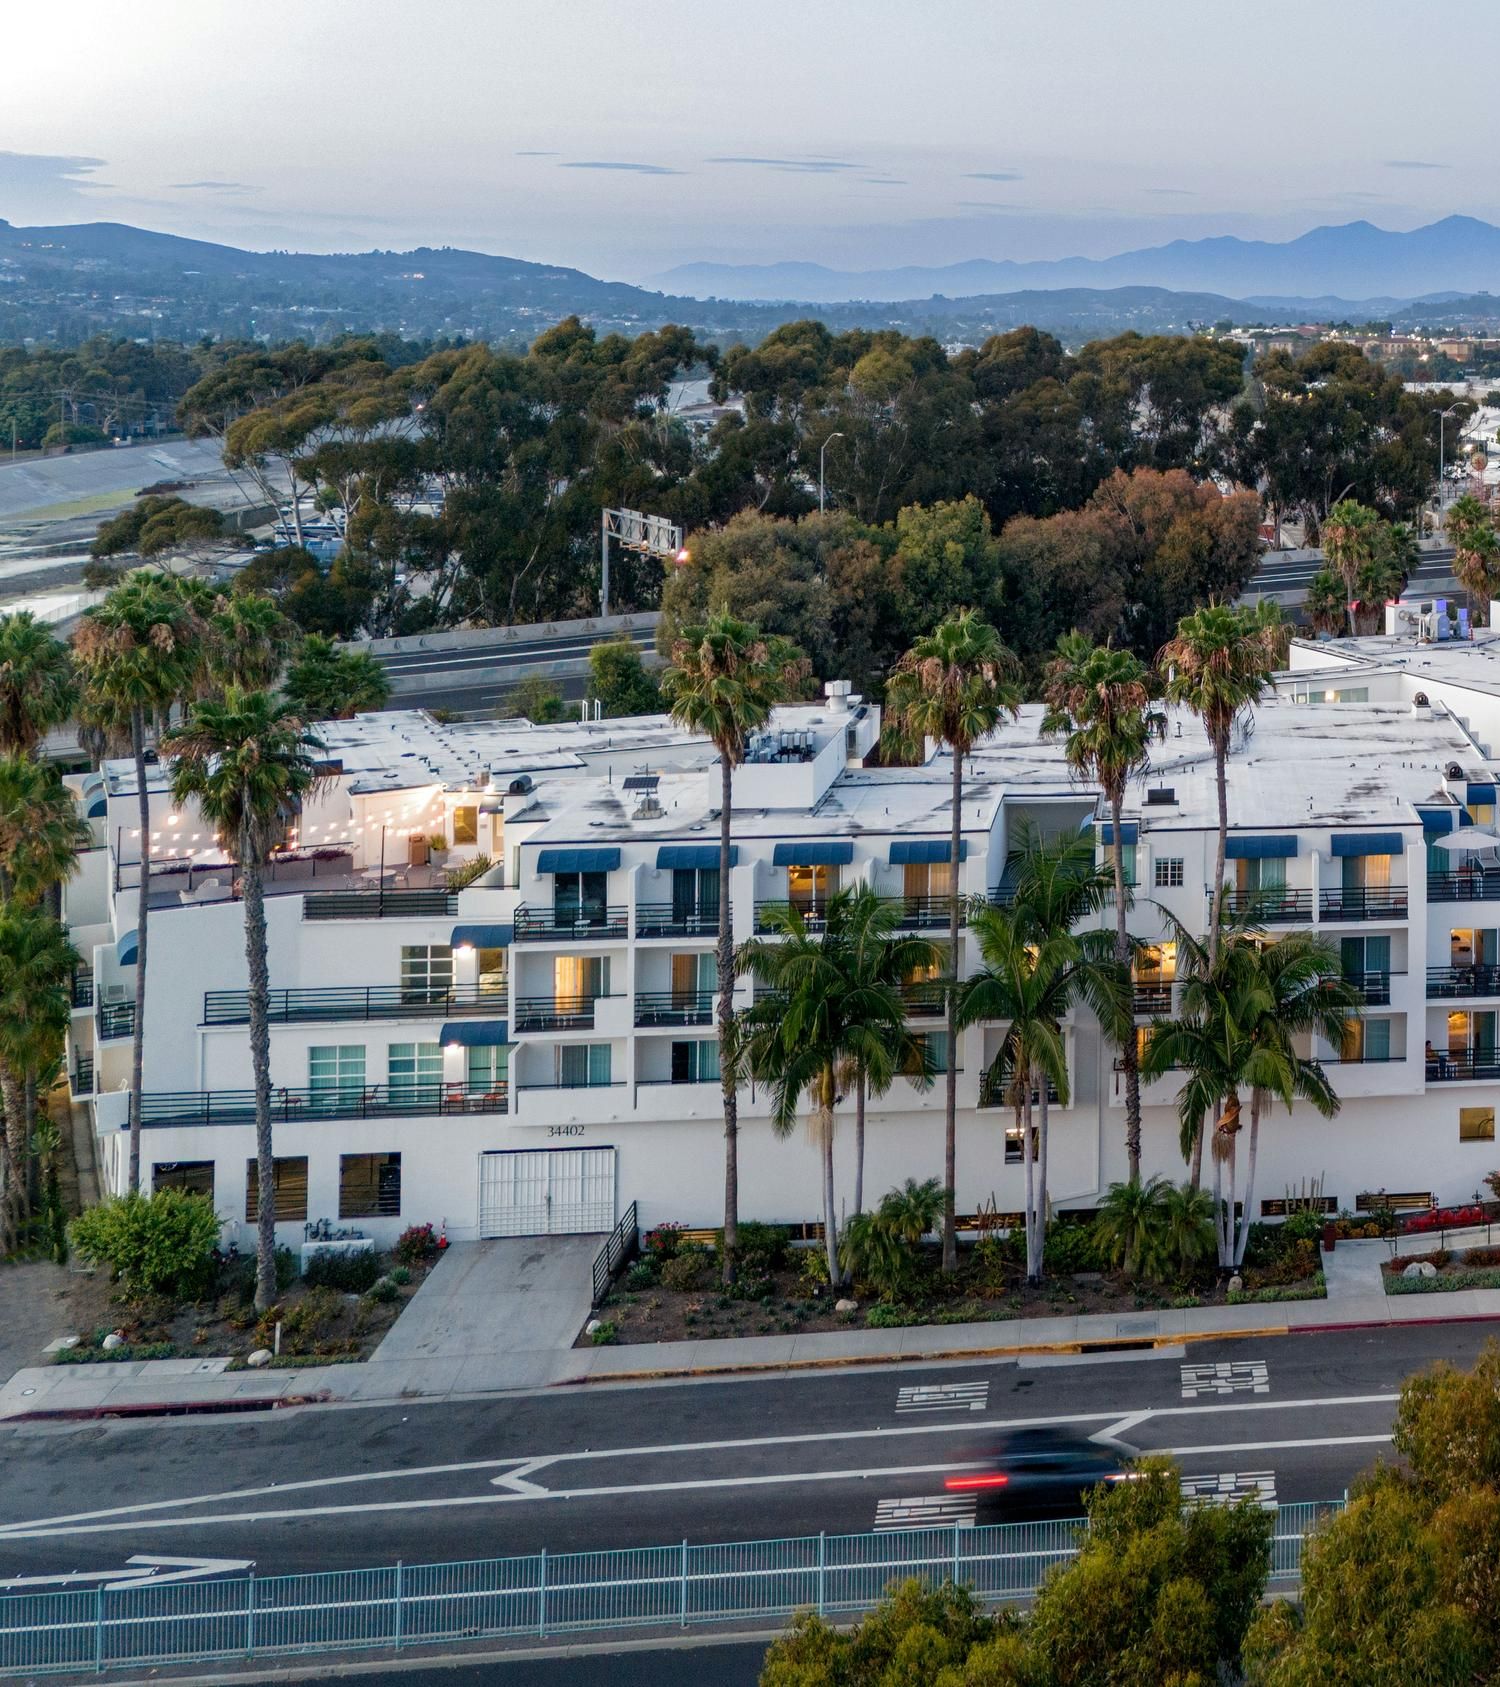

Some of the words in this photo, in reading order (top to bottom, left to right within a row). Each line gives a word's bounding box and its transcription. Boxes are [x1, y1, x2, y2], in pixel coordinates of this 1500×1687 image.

[547, 1124, 585, 1138] 34402
[1180, 1360, 1270, 1398] HERE
[895, 1381, 990, 1413] WAIT
[872, 1492, 978, 1532] WAIT
